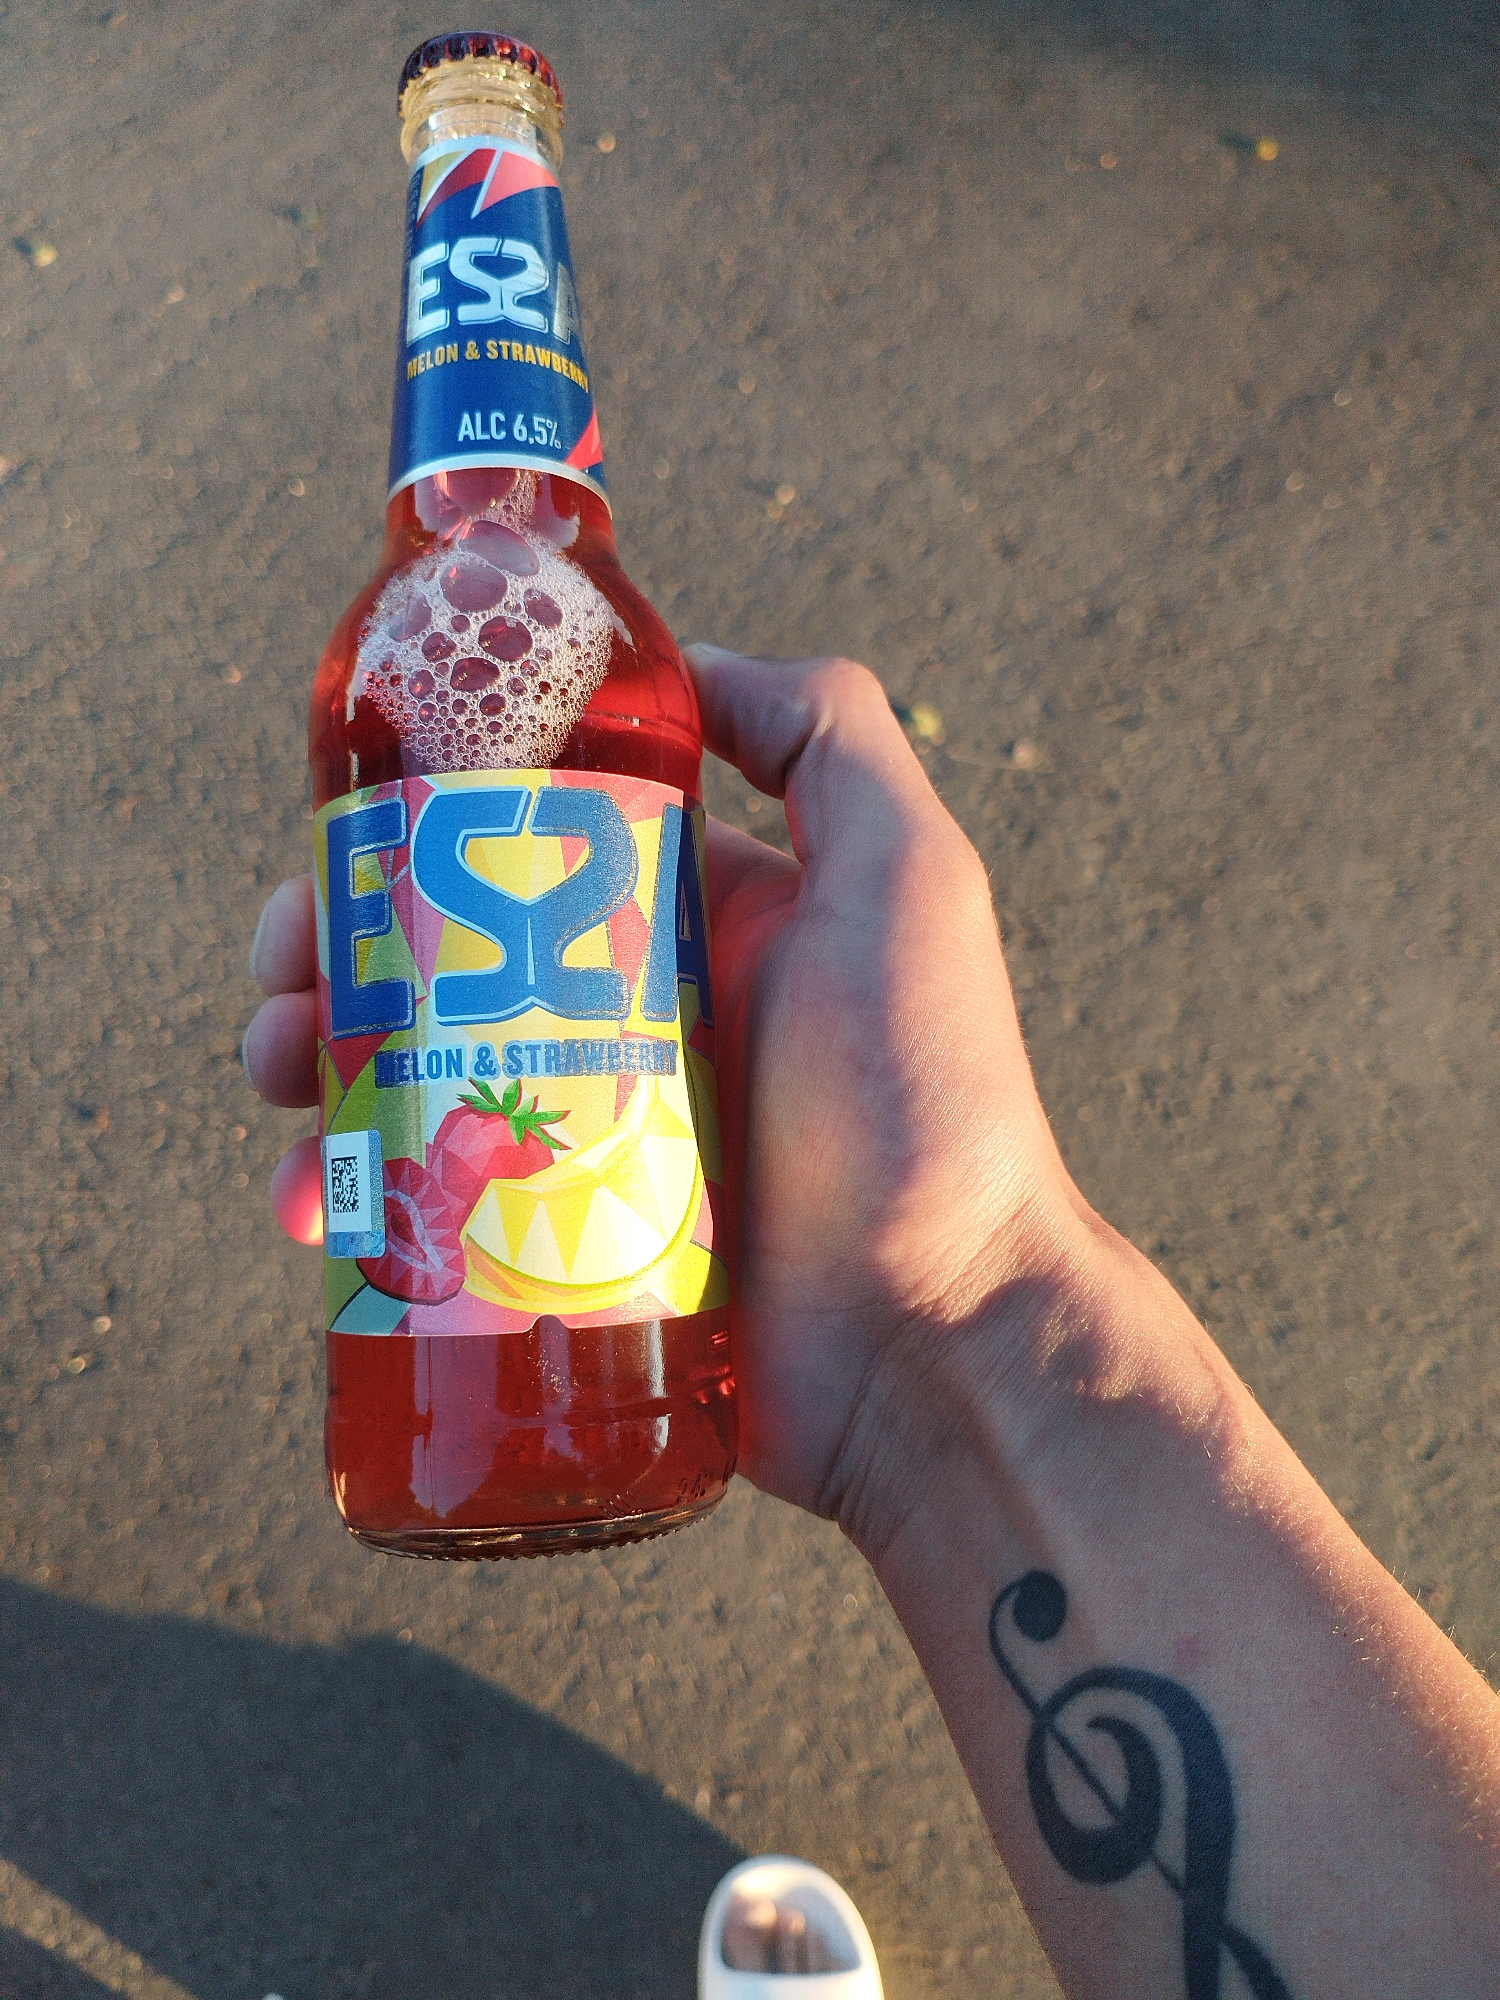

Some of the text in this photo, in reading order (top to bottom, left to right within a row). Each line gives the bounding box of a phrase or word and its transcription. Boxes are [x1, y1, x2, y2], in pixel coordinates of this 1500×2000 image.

[407, 343, 459, 382] MELON
[465, 340, 480, 361] &
[457, 412, 562, 450] ALC 6.5%
[376, 1042, 678, 1083] MELON & STRAWBERRY
